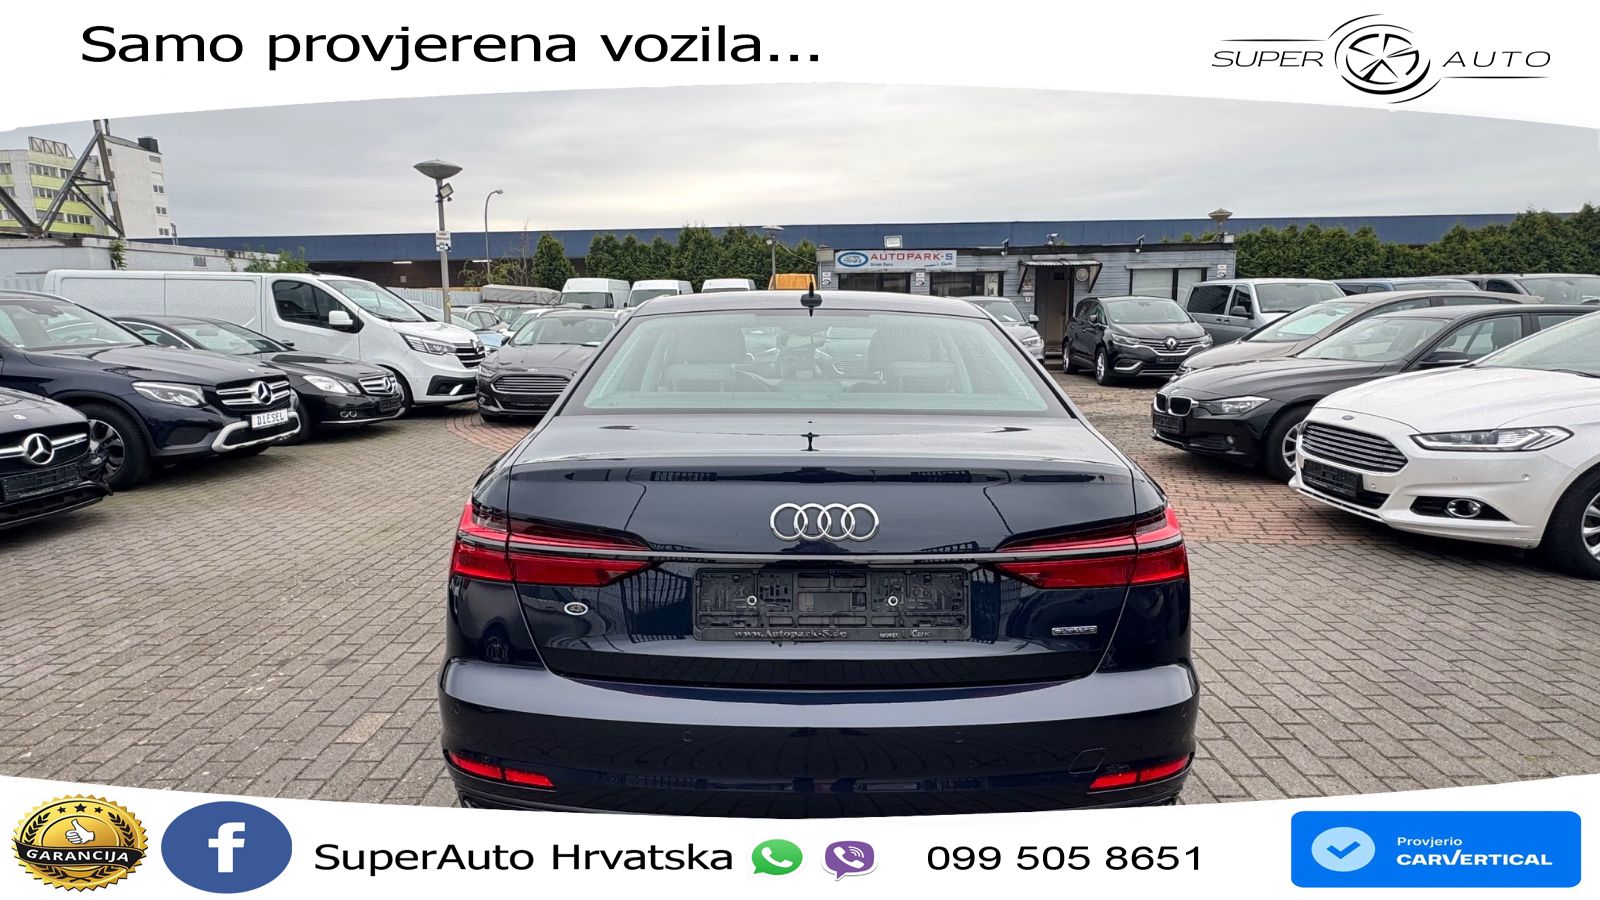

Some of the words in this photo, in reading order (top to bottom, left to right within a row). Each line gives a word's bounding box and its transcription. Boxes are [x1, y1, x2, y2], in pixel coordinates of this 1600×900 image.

[870, 252, 953, 261] AUTOPARK-S
[256, 411, 285, 426] DIESEL
[734, 628, 848, 640] www.Autopark-S.de
